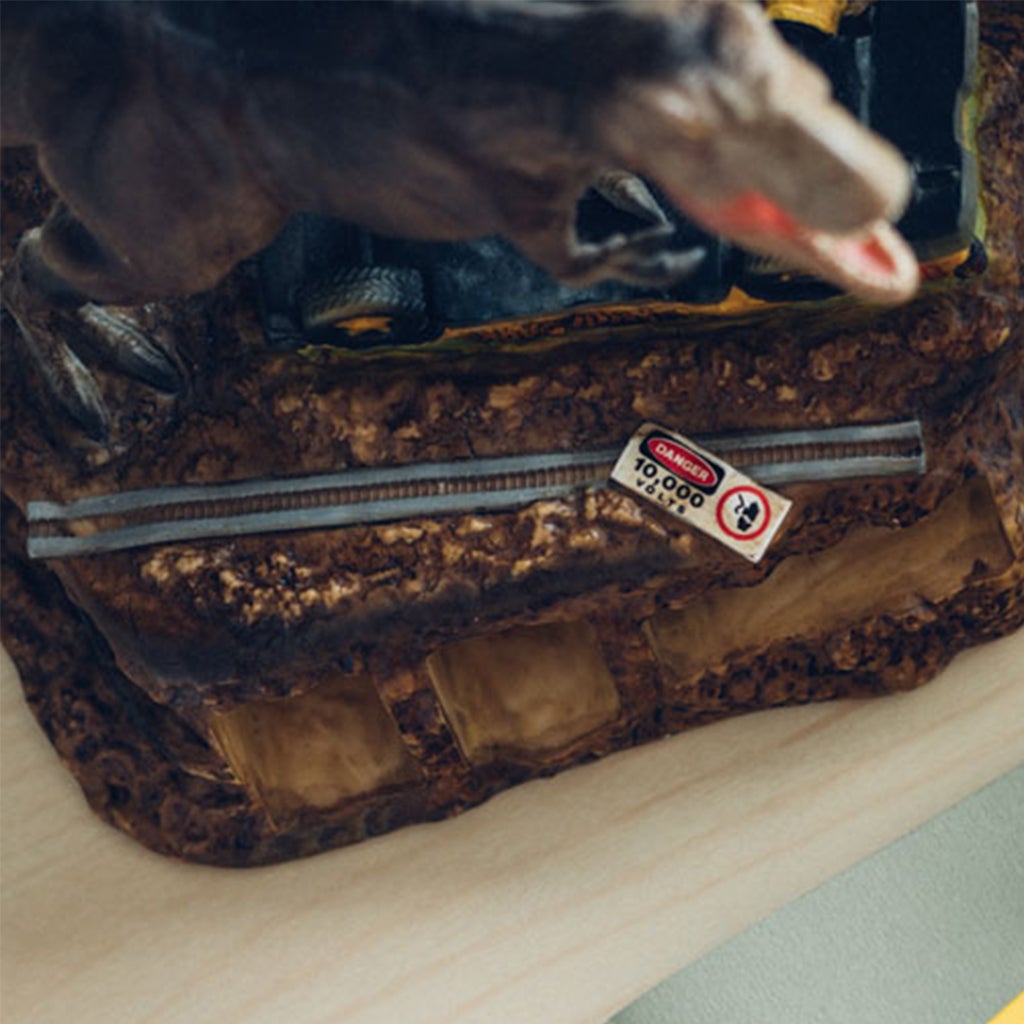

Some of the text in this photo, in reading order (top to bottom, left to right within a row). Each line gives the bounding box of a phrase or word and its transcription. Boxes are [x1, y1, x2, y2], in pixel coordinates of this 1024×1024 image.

[655, 443, 709, 481] DANGER
[634, 457, 704, 508] 10,000
[636, 478, 685, 515] VOLTS
